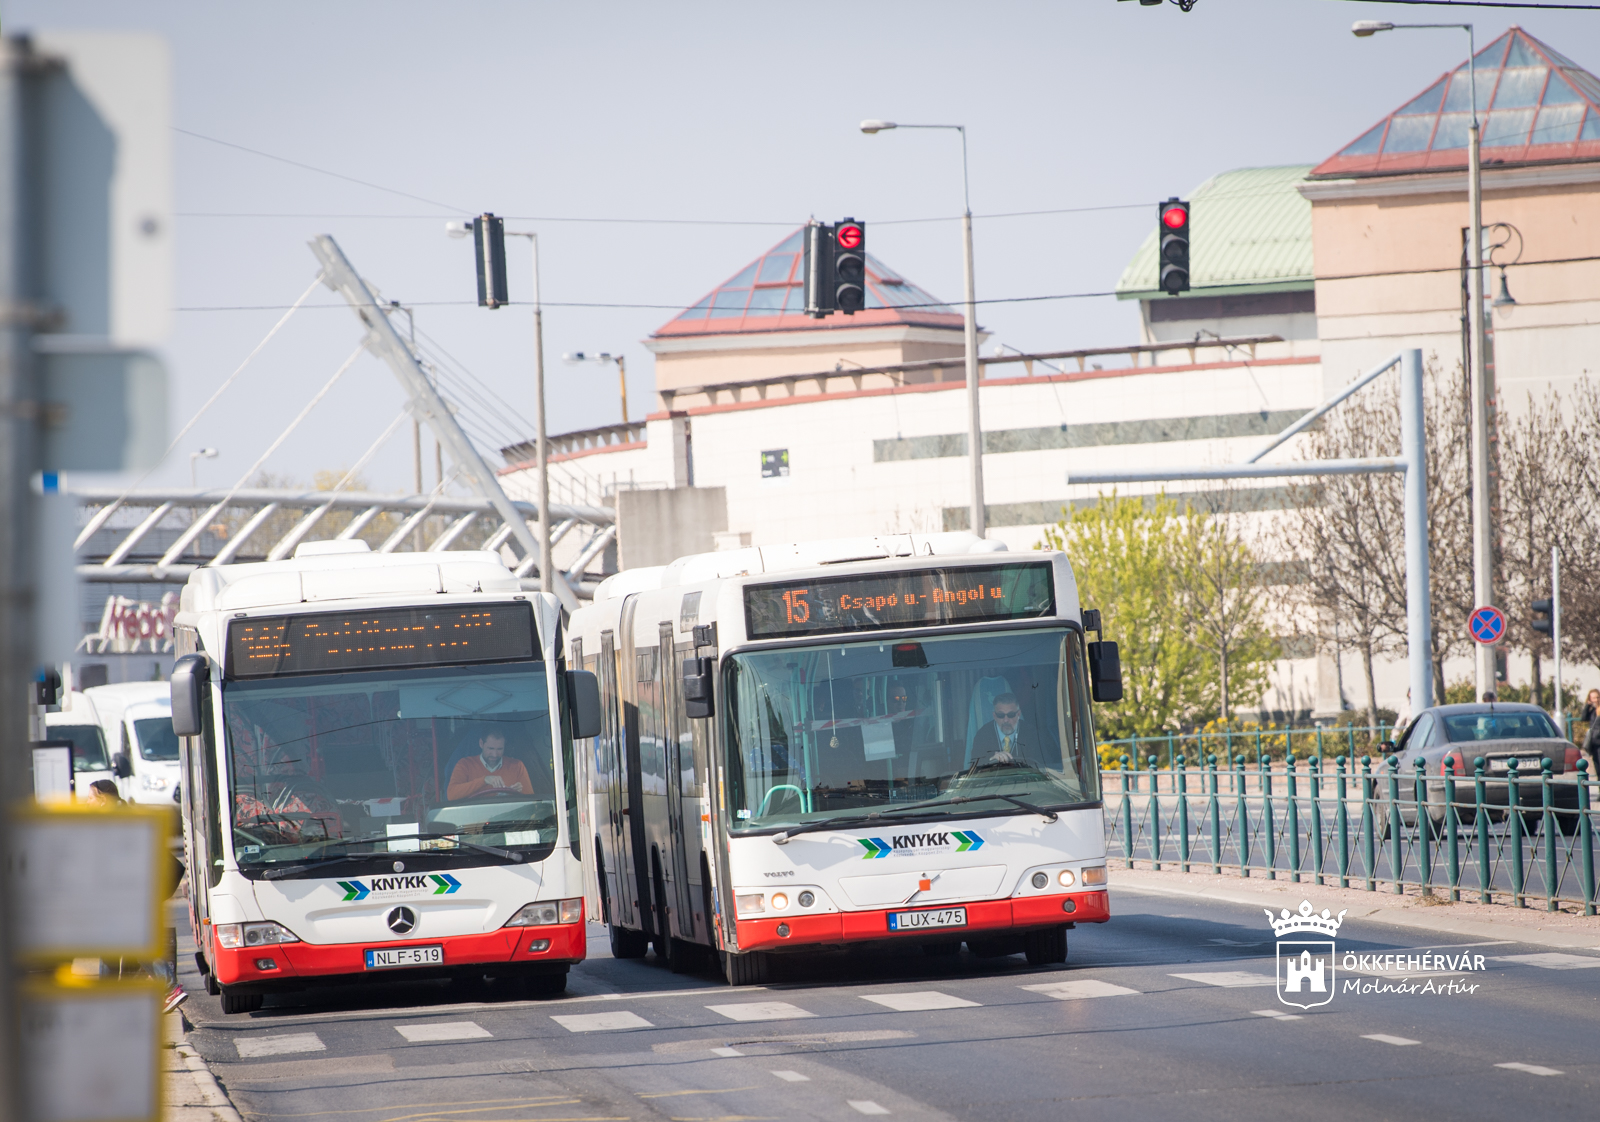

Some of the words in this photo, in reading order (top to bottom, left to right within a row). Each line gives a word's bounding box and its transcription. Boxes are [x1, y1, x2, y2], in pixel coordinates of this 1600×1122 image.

[782, 589, 810, 623] 15
[840, 593, 898, 611] Csapó
[932, 584, 984, 607] Angol
[990, 586, 1006, 599] u.
[892, 832, 950, 849] KNYKK
[763, 870, 795, 878] VOLVO
[371, 875, 428, 892] KNYKK
[900, 910, 962, 928] LUX-475
[376, 948, 439, 965] NLF-519
